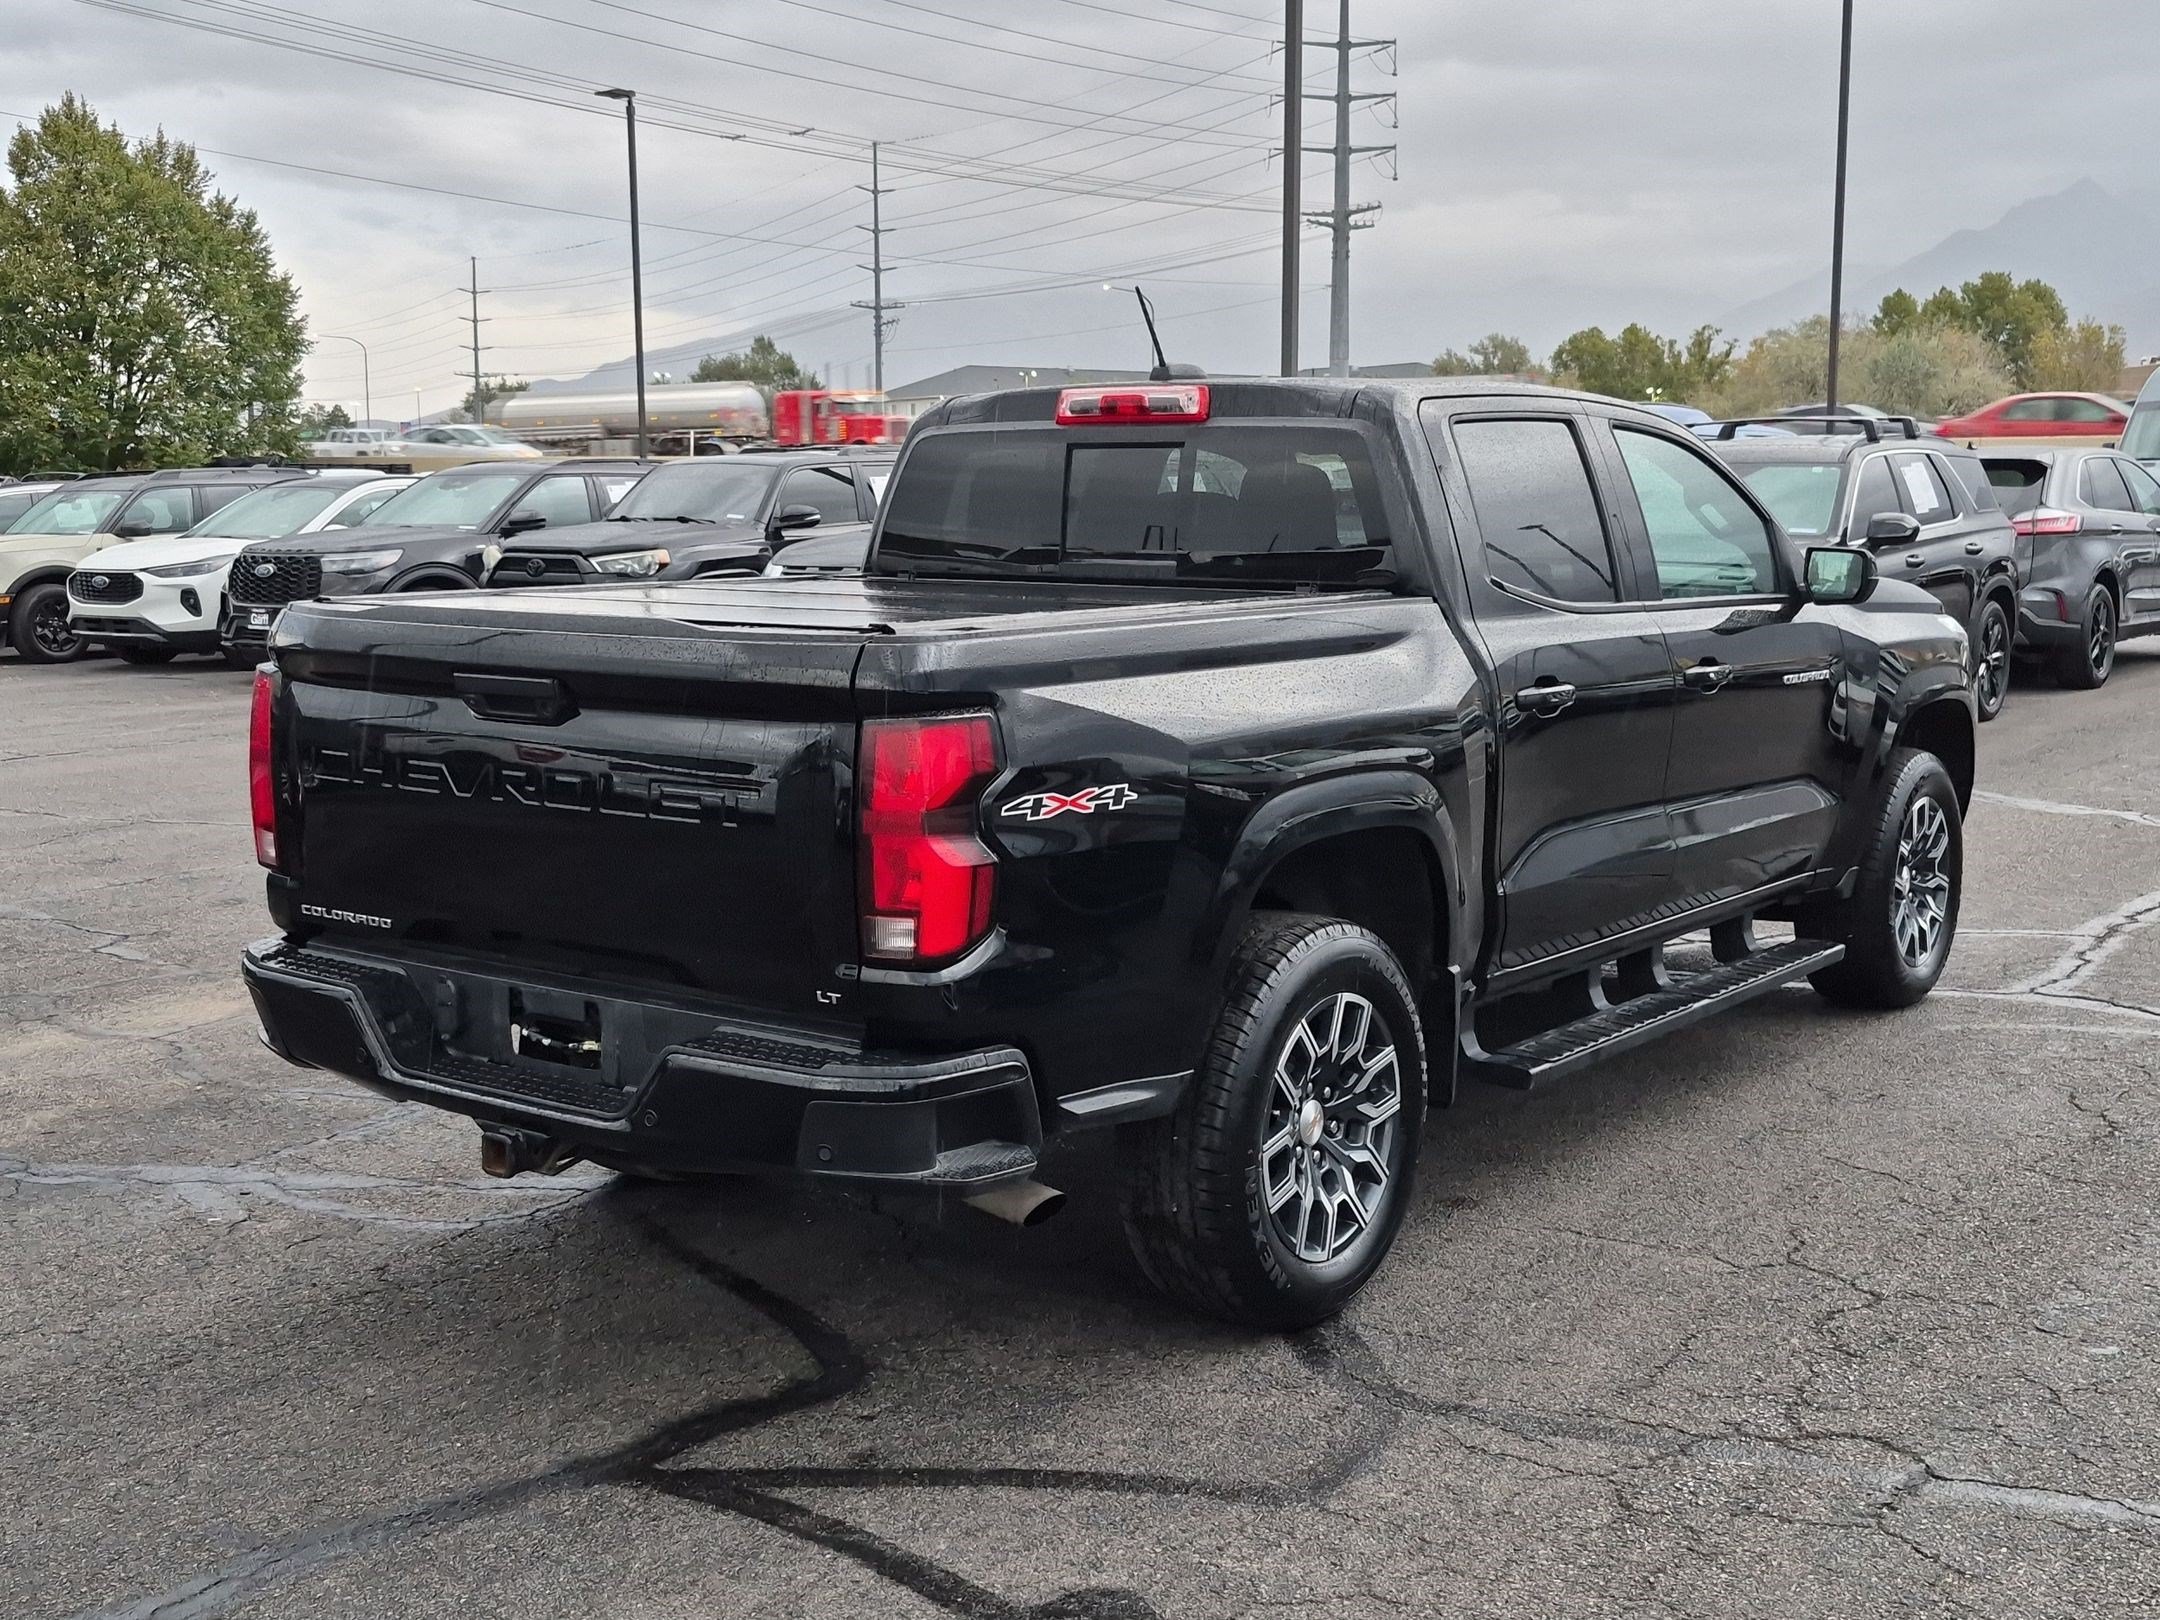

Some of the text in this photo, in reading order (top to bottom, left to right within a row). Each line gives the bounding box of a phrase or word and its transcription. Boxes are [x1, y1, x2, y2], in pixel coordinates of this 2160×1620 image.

[307, 748, 762, 829] CHEVROLET
[301, 904, 391, 928] COLORADO
[816, 990, 842, 1005] LT
